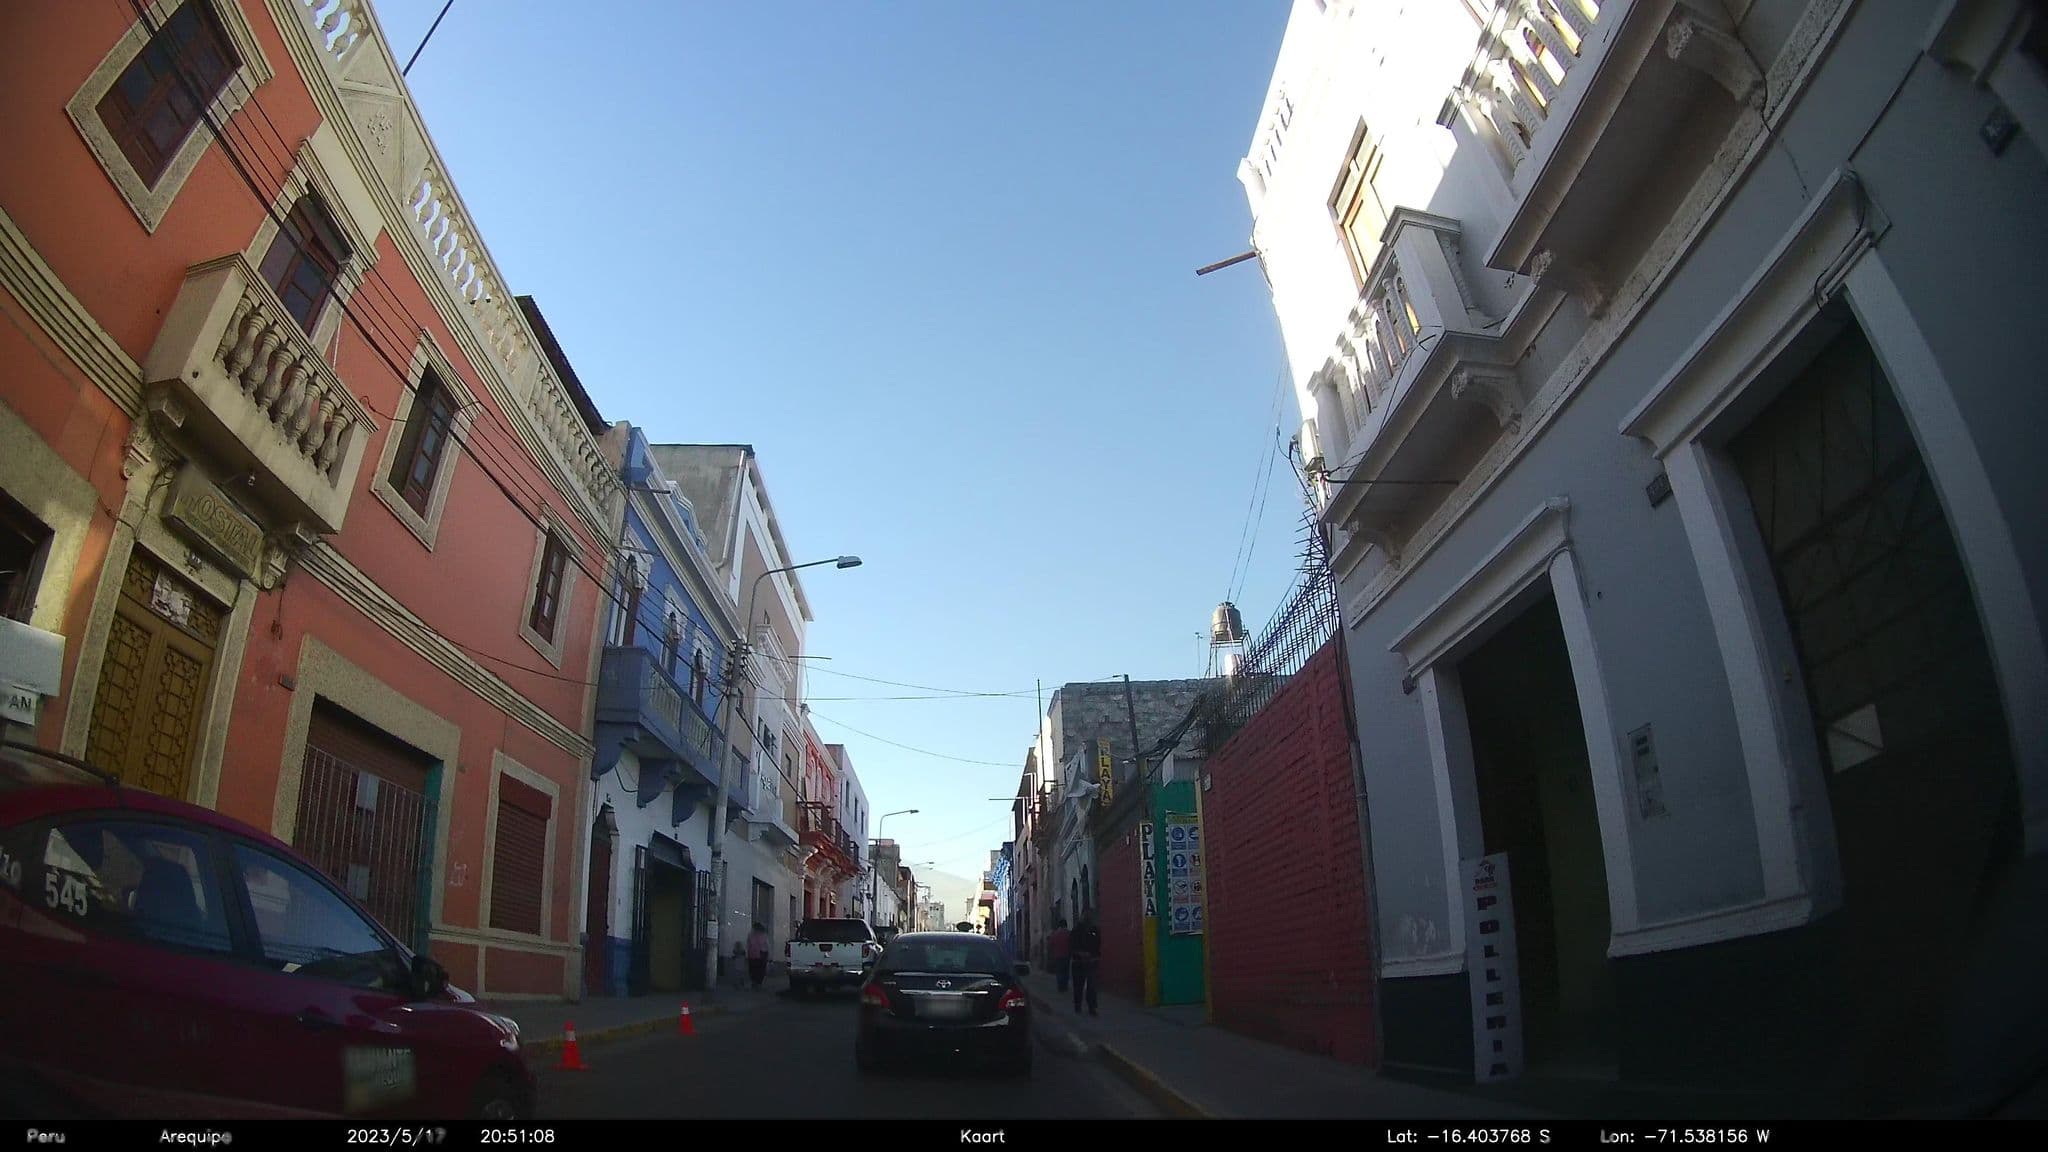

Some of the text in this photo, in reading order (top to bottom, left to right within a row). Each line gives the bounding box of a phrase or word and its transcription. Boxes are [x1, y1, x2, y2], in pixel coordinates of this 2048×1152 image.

[1101, 746, 1111, 801] PLAYA
[46, 872, 88, 917] 545
[1141, 823, 1157, 916] PLAYA
[1476, 895, 1507, 1077] POLLERIA
